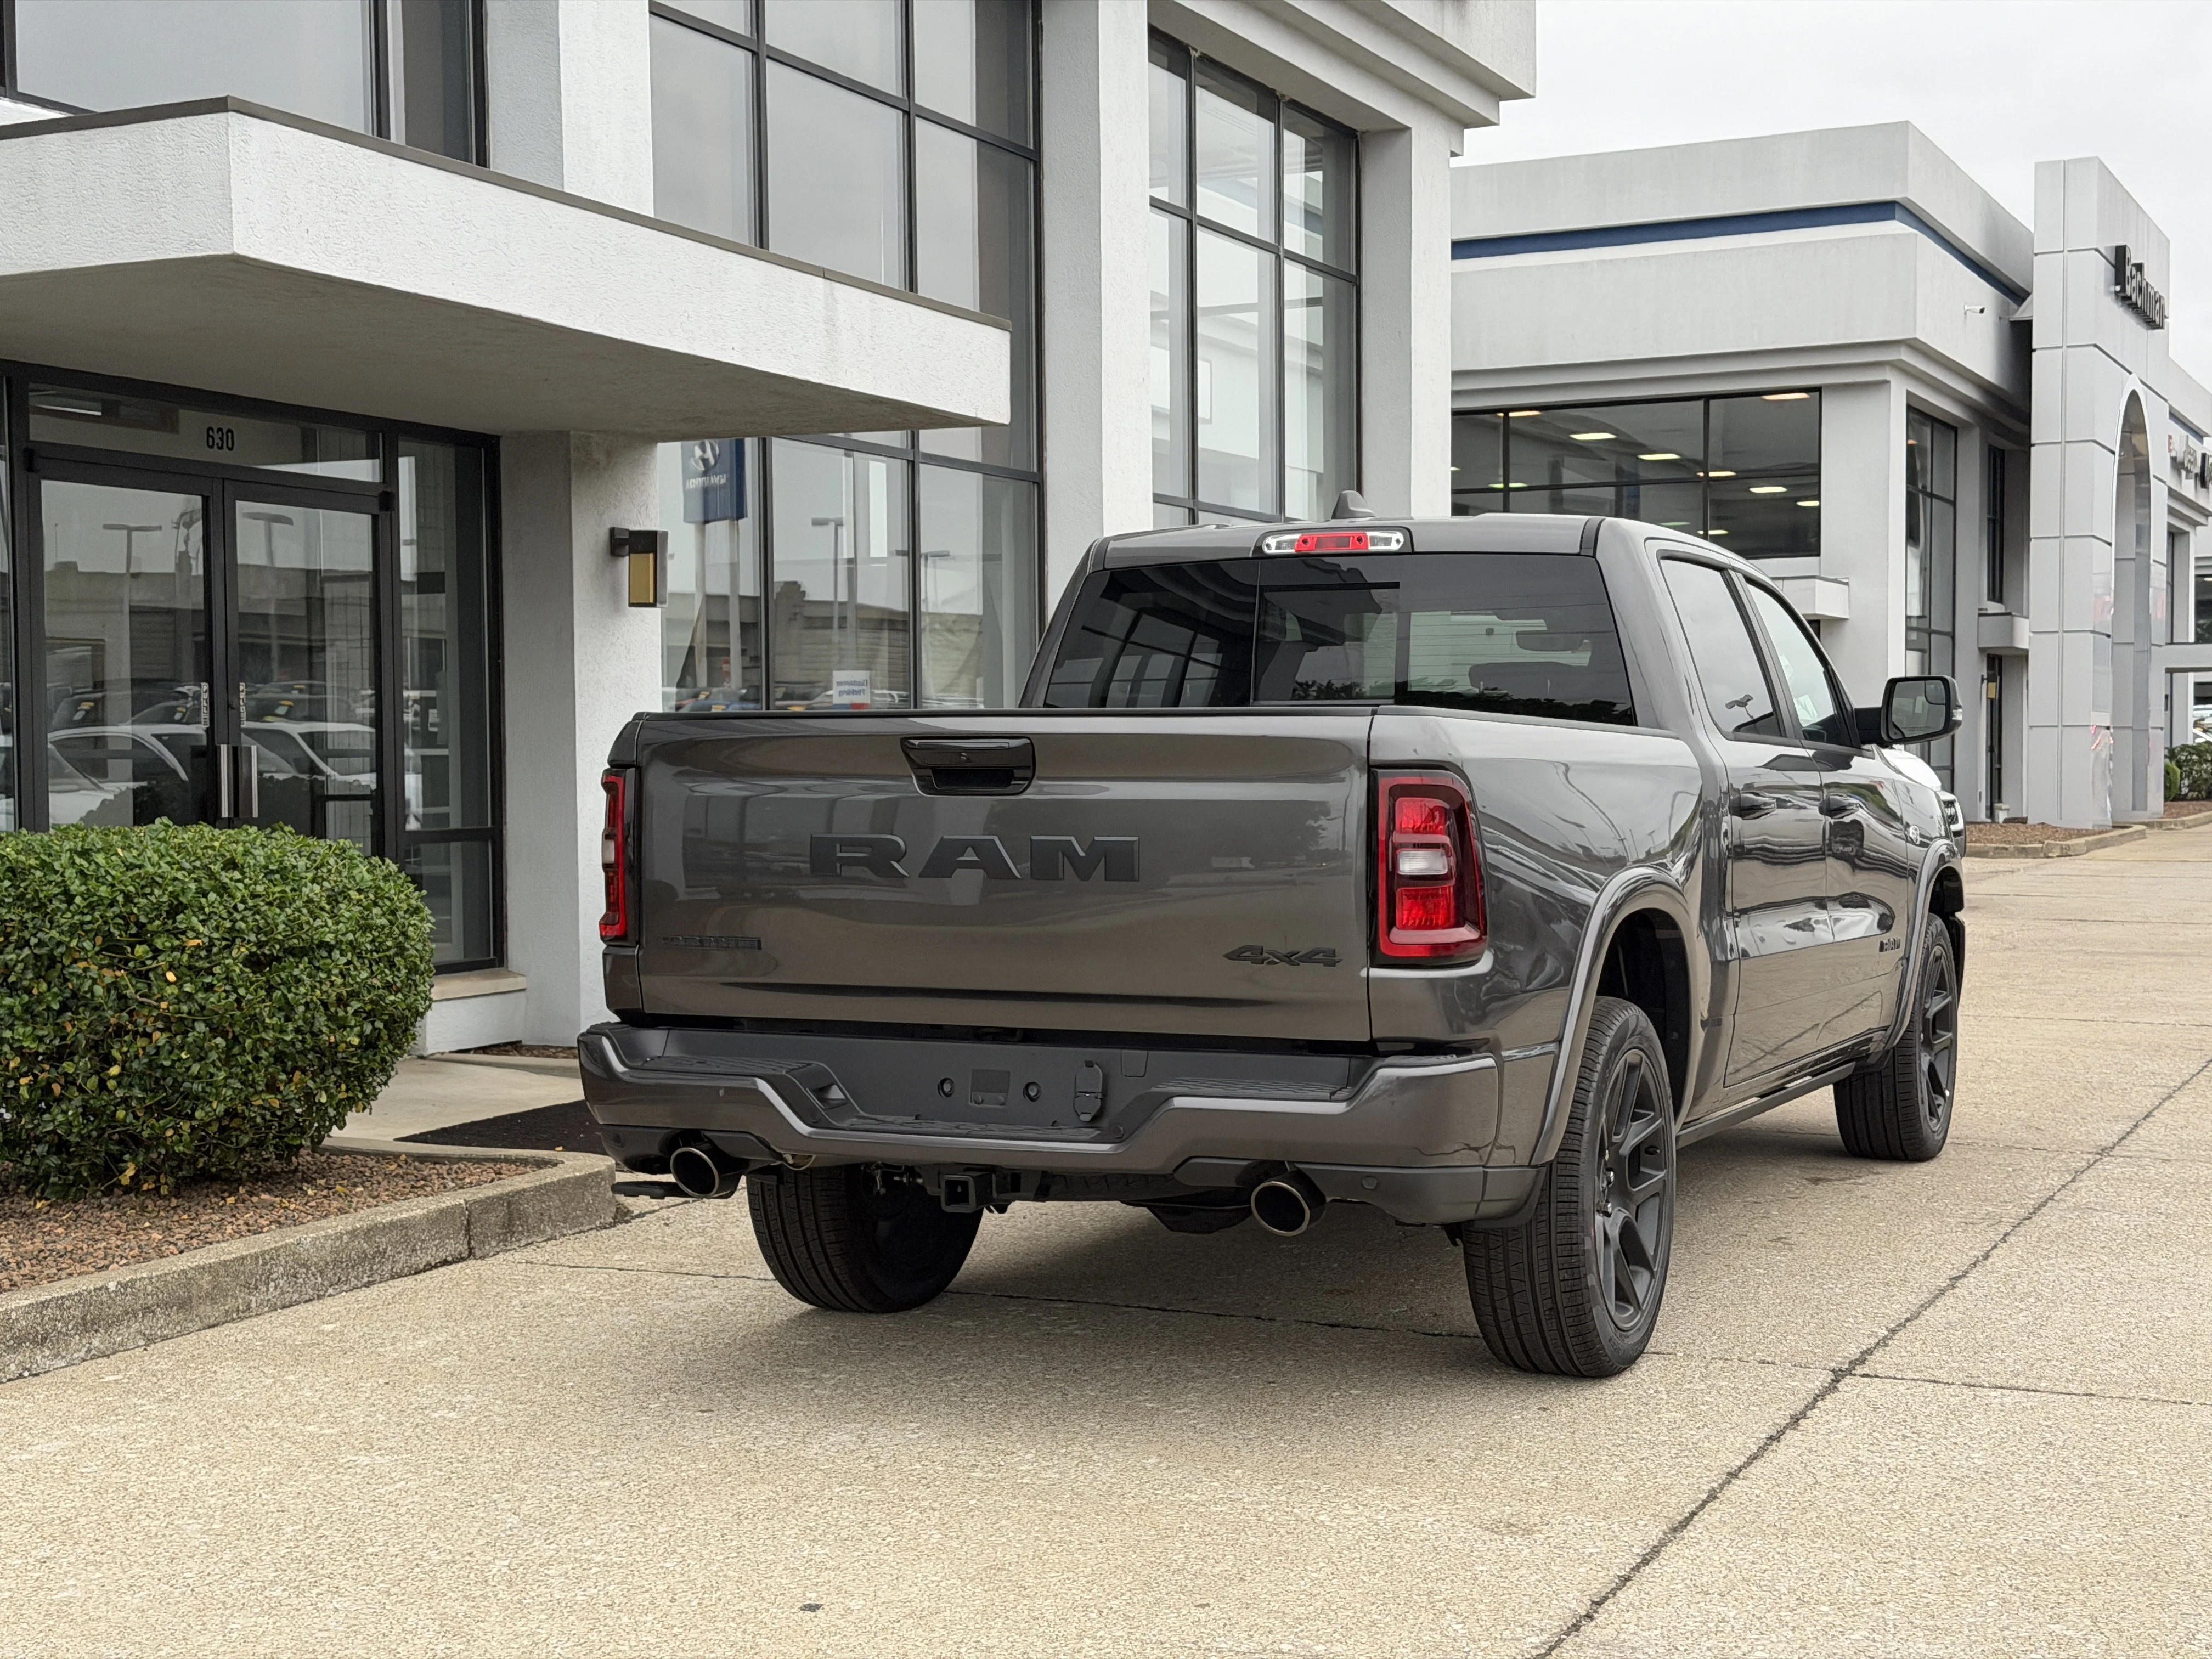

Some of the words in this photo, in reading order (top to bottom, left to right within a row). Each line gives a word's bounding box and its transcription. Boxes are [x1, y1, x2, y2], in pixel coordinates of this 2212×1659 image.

[2116, 245, 2165, 329] Bachman
[206, 426, 235, 451] 630
[810, 833, 1140, 882] RAM
